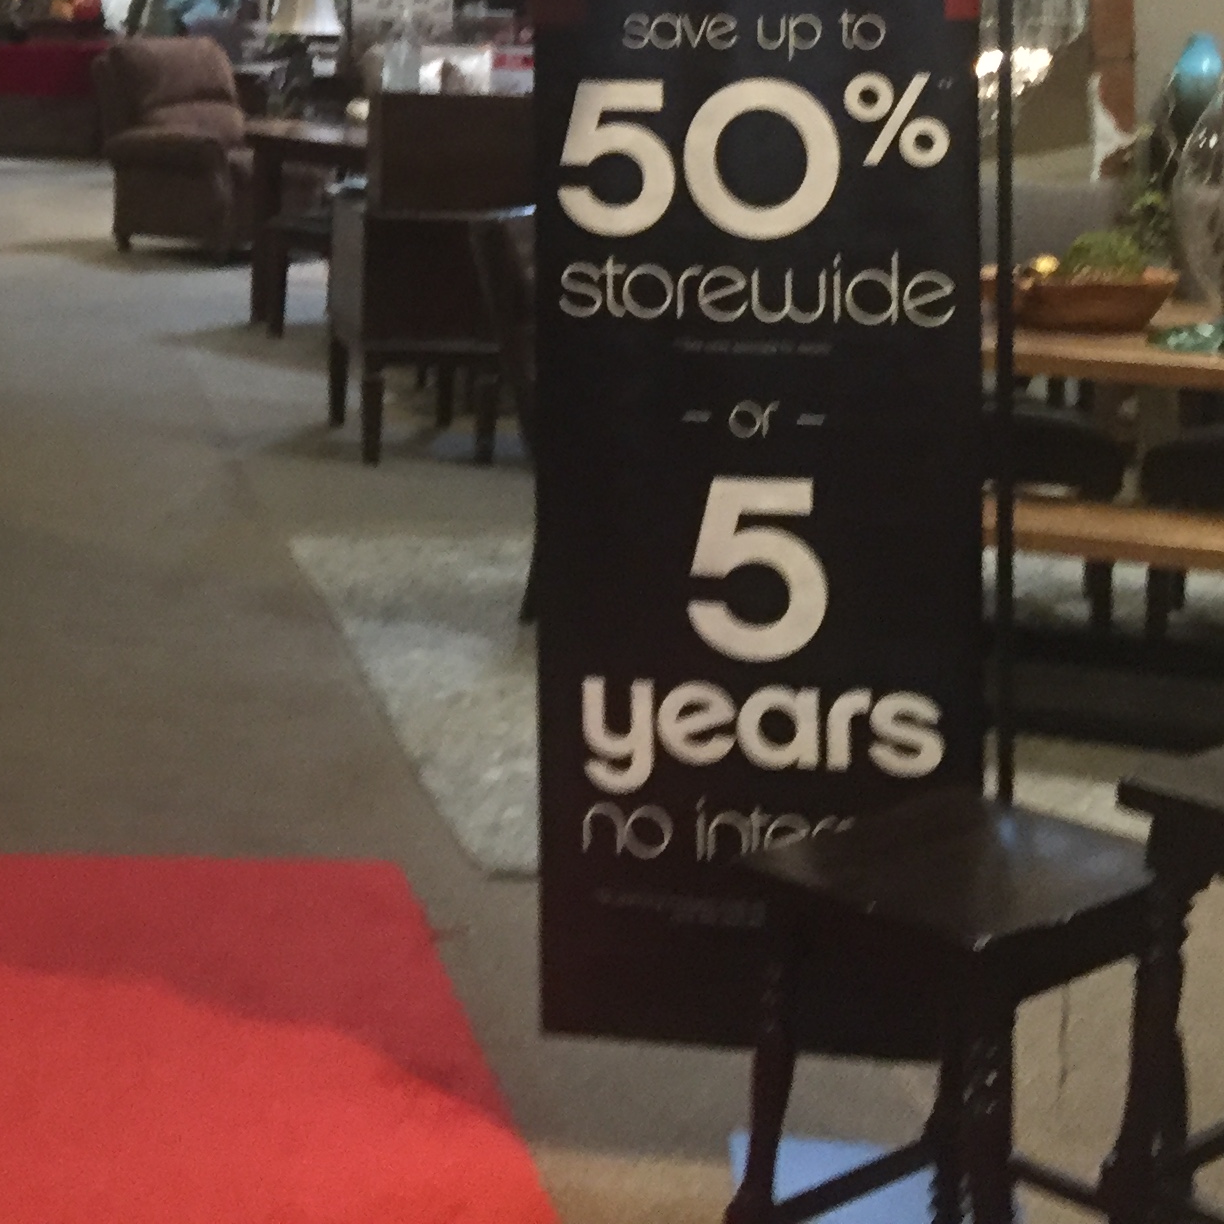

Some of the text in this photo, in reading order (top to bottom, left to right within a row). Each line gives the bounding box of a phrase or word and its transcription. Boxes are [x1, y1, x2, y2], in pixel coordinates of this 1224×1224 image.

[622, 8, 887, 62] save up to
[556, 70, 952, 242] 50%
[558, 248, 957, 329] storewide
[727, 399, 781, 440] or
[685, 475, 829, 663] 5
[581, 674, 946, 795] years
[582, 801, 673, 860] no
